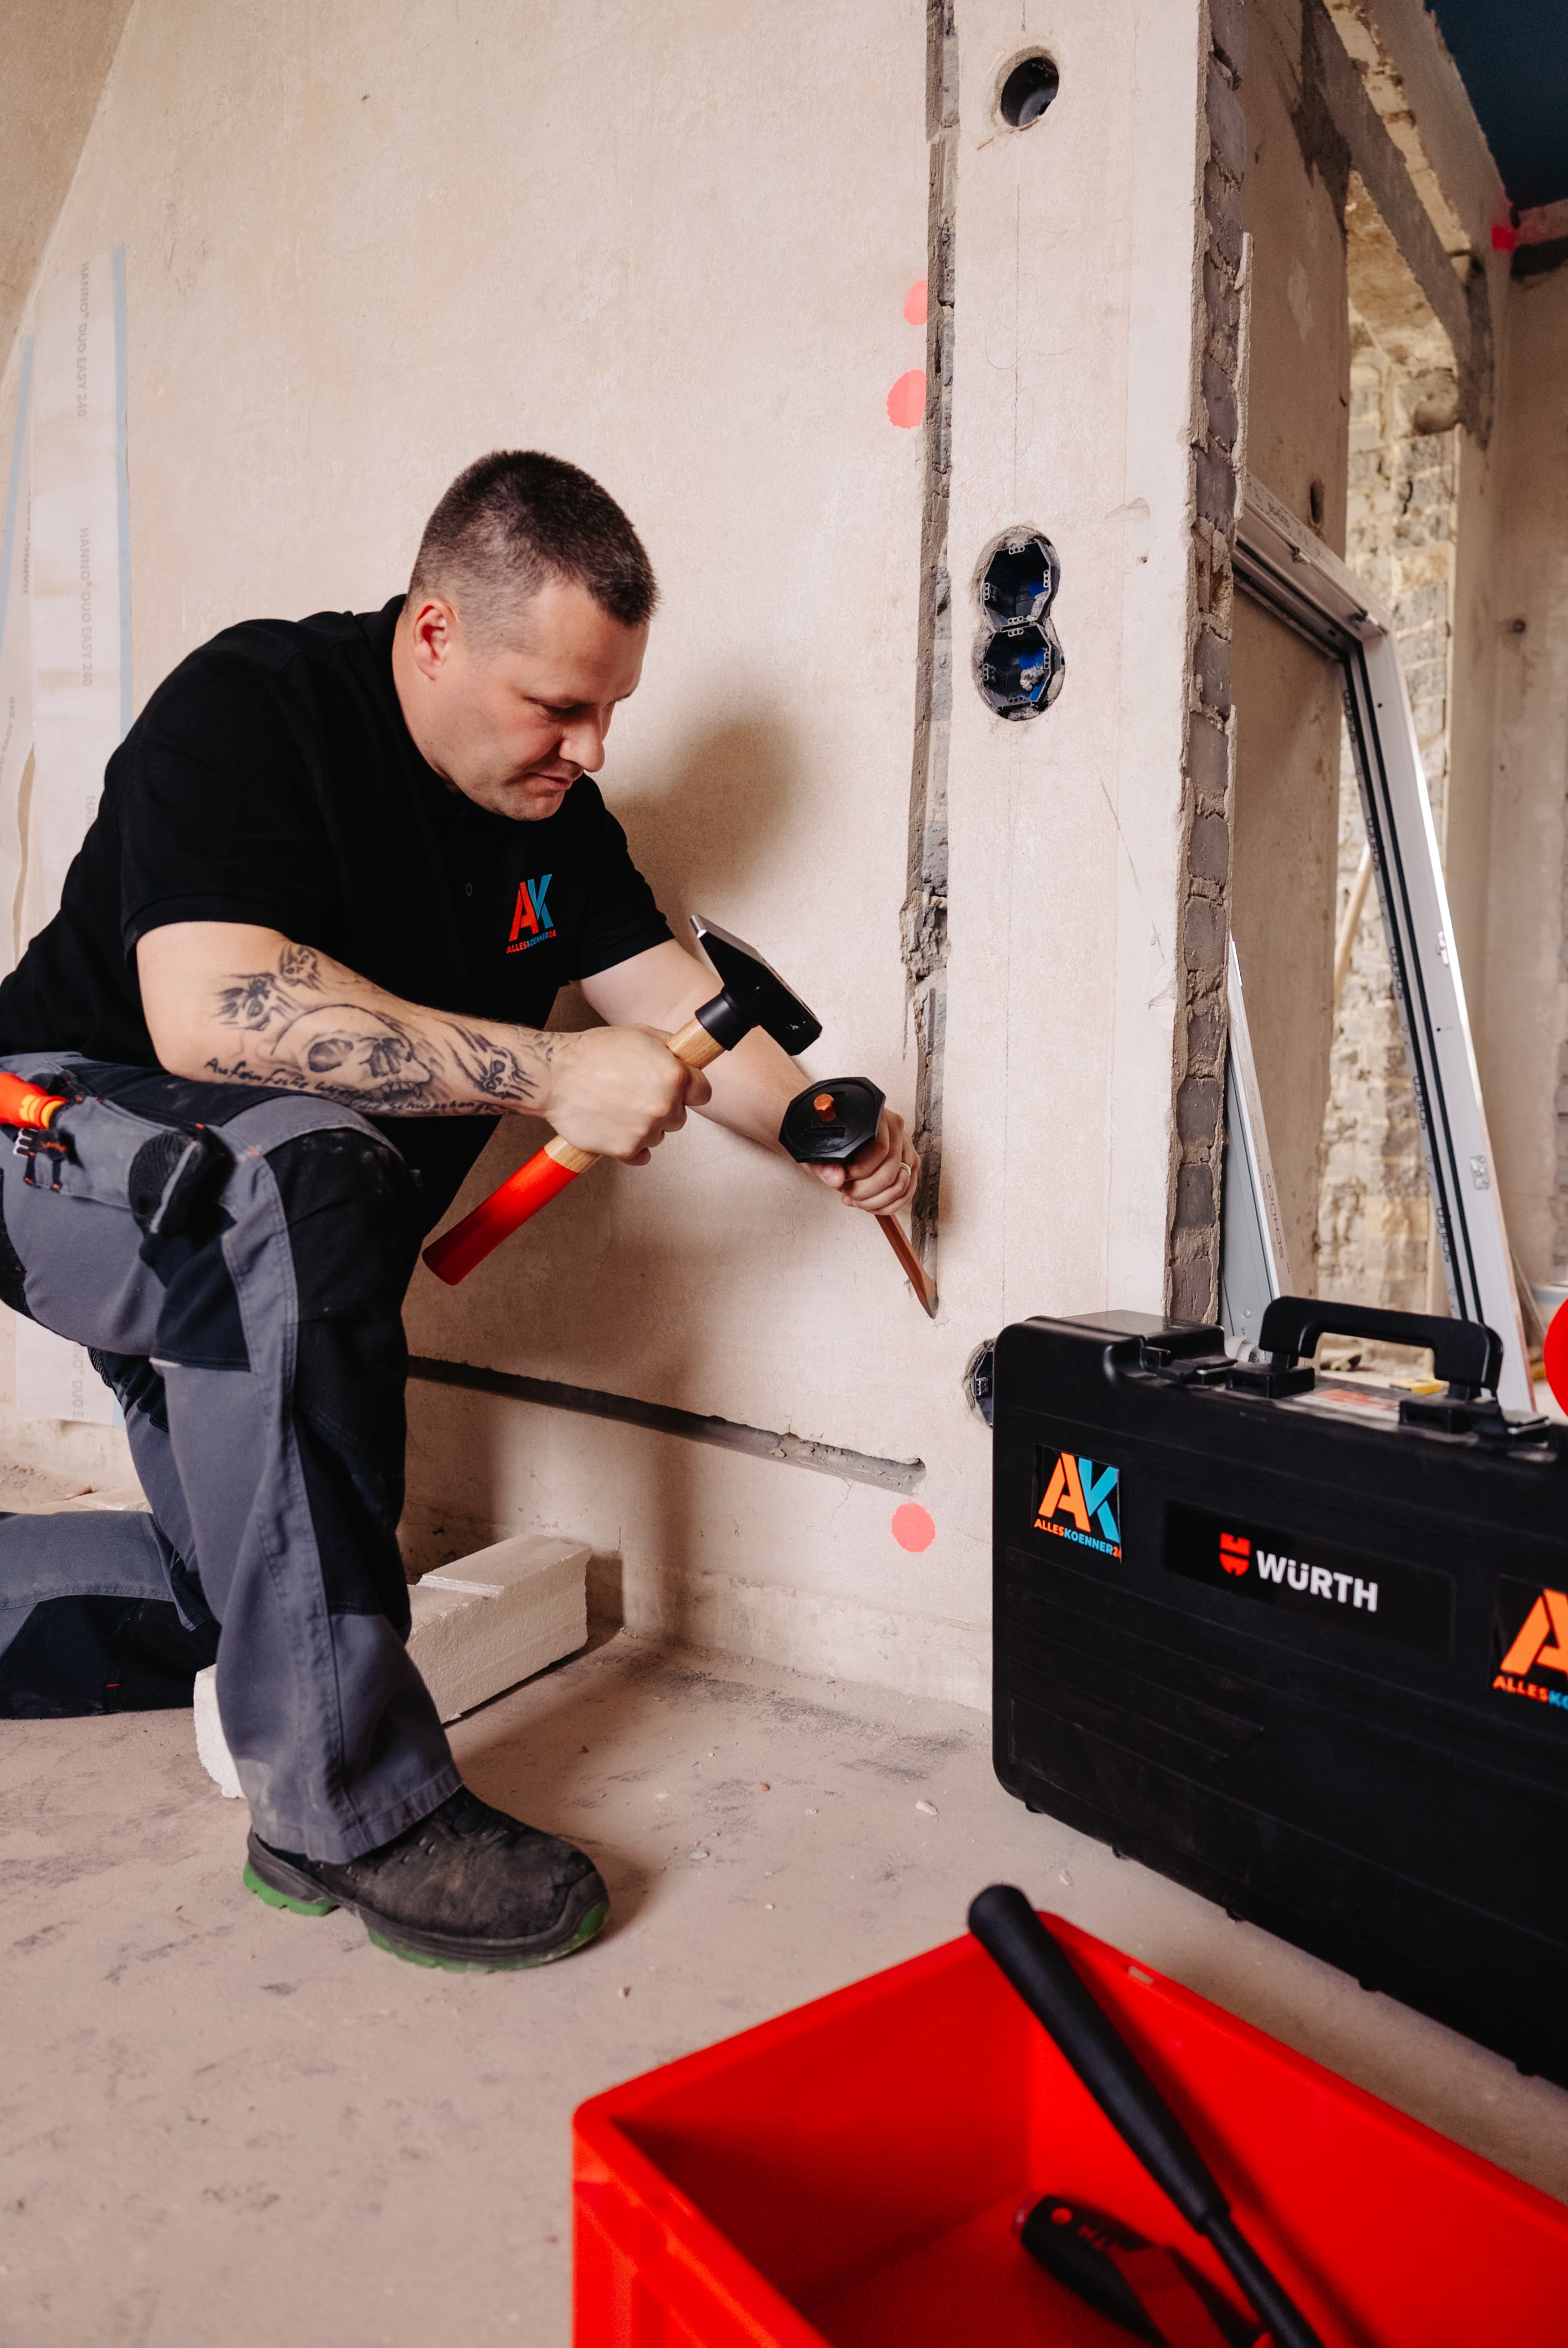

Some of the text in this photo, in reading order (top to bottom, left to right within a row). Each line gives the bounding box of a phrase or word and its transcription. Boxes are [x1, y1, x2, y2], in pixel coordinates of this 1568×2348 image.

[78, 323, 87, 353] DUO
[76, 357, 87, 390] EASY
[77, 394, 87, 417] 240
[81, 592, 91, 621] DUO
[81, 626, 92, 659] EASY
[82, 663, 93, 686] 240
[506, 930, 556, 954] ALLESKOENNER24
[73, 1380, 84, 1408] DUO
[1038, 1452, 1120, 1543] AK
[1256, 1550, 1379, 1613] WÜRTH
